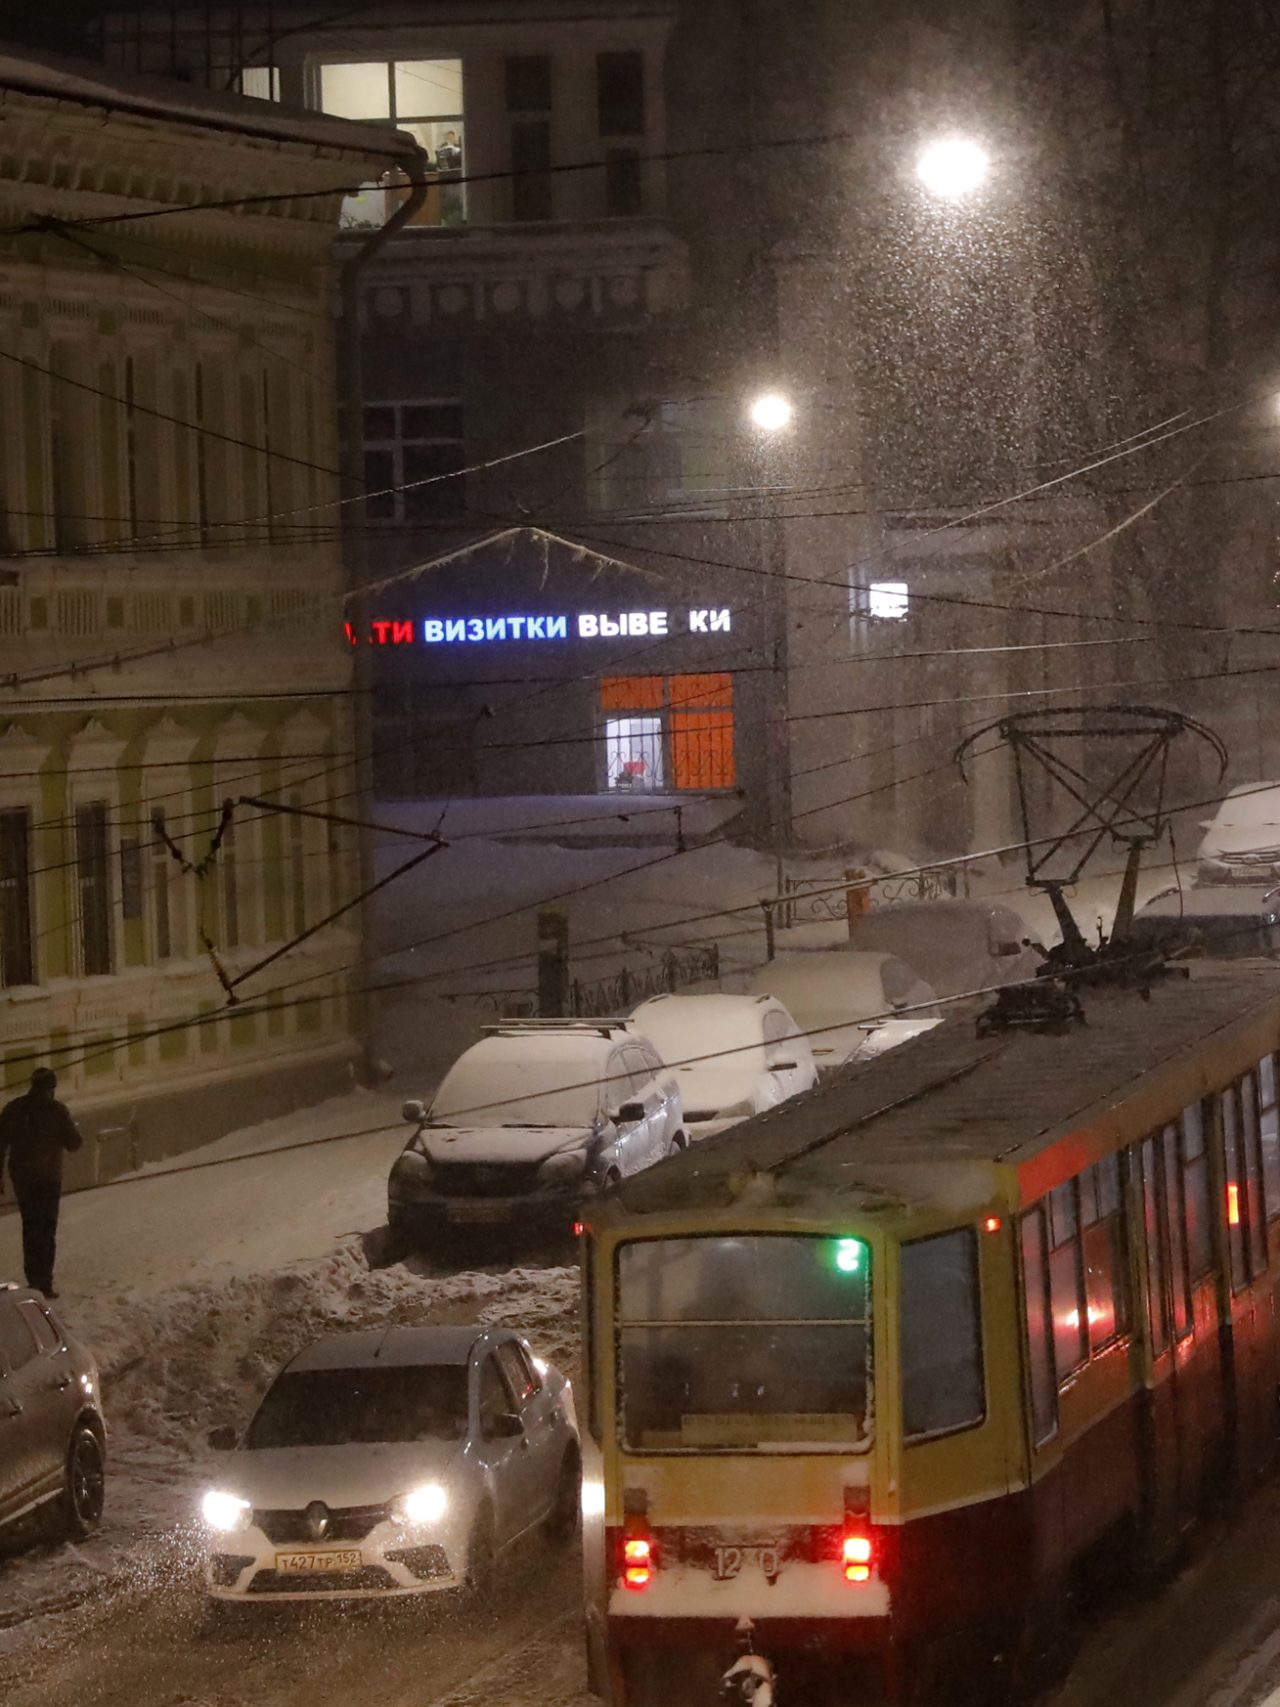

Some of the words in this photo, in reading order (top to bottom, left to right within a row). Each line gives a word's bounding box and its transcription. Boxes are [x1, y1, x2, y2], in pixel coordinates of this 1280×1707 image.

[423, 615, 567, 643] ВИЗИТКИ
[578, 609, 731, 638] ВЫВЕКИ
[282, 1556, 333, 1570] Т427ТР
[336, 1553, 356, 1564] 152
